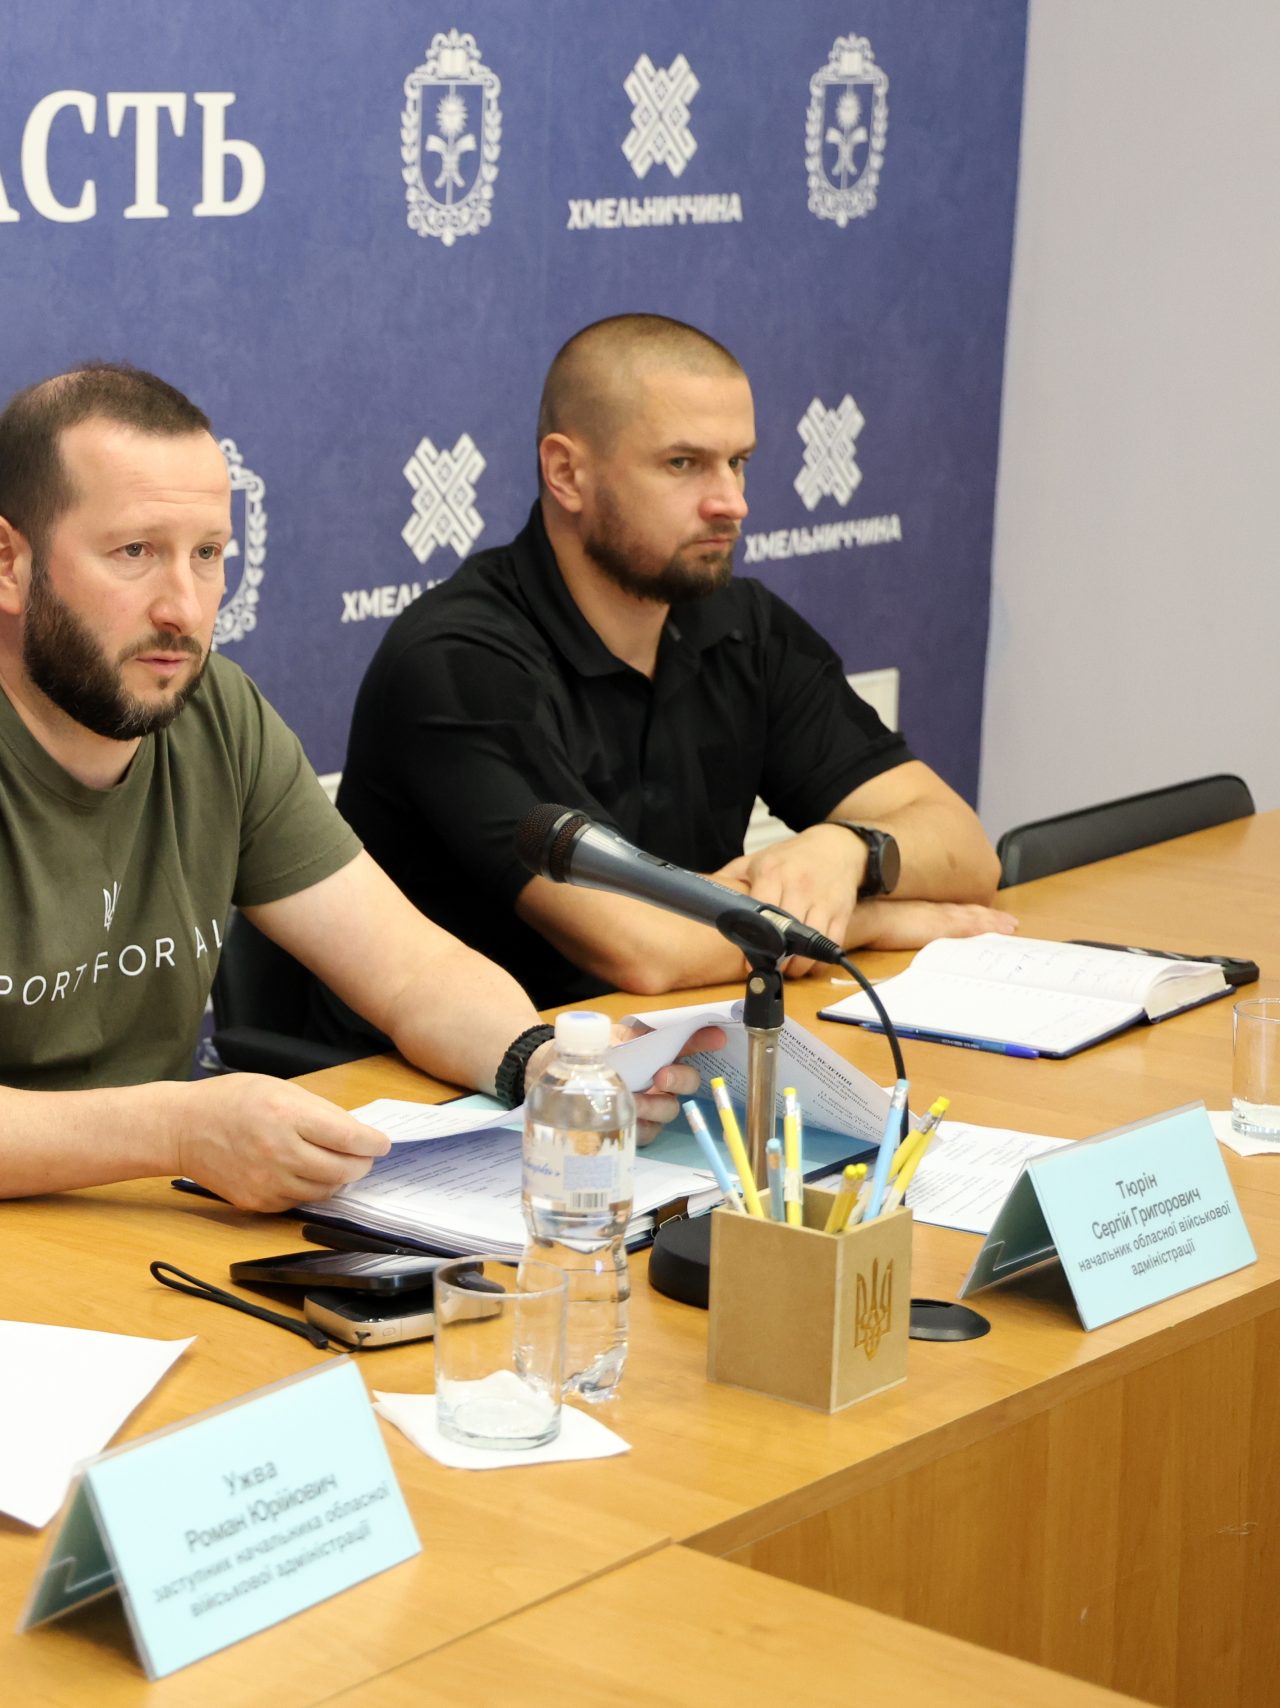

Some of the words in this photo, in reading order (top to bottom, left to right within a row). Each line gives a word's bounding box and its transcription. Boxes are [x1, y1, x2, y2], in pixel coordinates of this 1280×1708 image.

[567, 192, 743, 230] ХМЕЛЬНИЧЧИНА
[744, 514, 902, 563] ХМЕЛЬНИЧЧИНА
[93, 937, 176, 983] FOR
[1116, 1172, 1158, 1199] Тюрін
[1078, 1242, 1132, 1272] начальник
[1133, 1221, 1178, 1251] обласної
[1179, 1201, 1231, 1232] військової
[1091, 1211, 1132, 1240] Сергій
[1131, 1187, 1201, 1227] Григорович
[1131, 1238, 1195, 1276] адміністрації
[222, 1461, 278, 1496] Ужва
[184, 1515, 247, 1553] Роман
[247, 1474, 338, 1525] Юрійович
[236, 1515, 323, 1564] начальника
[324, 1480, 389, 1523] обласної
